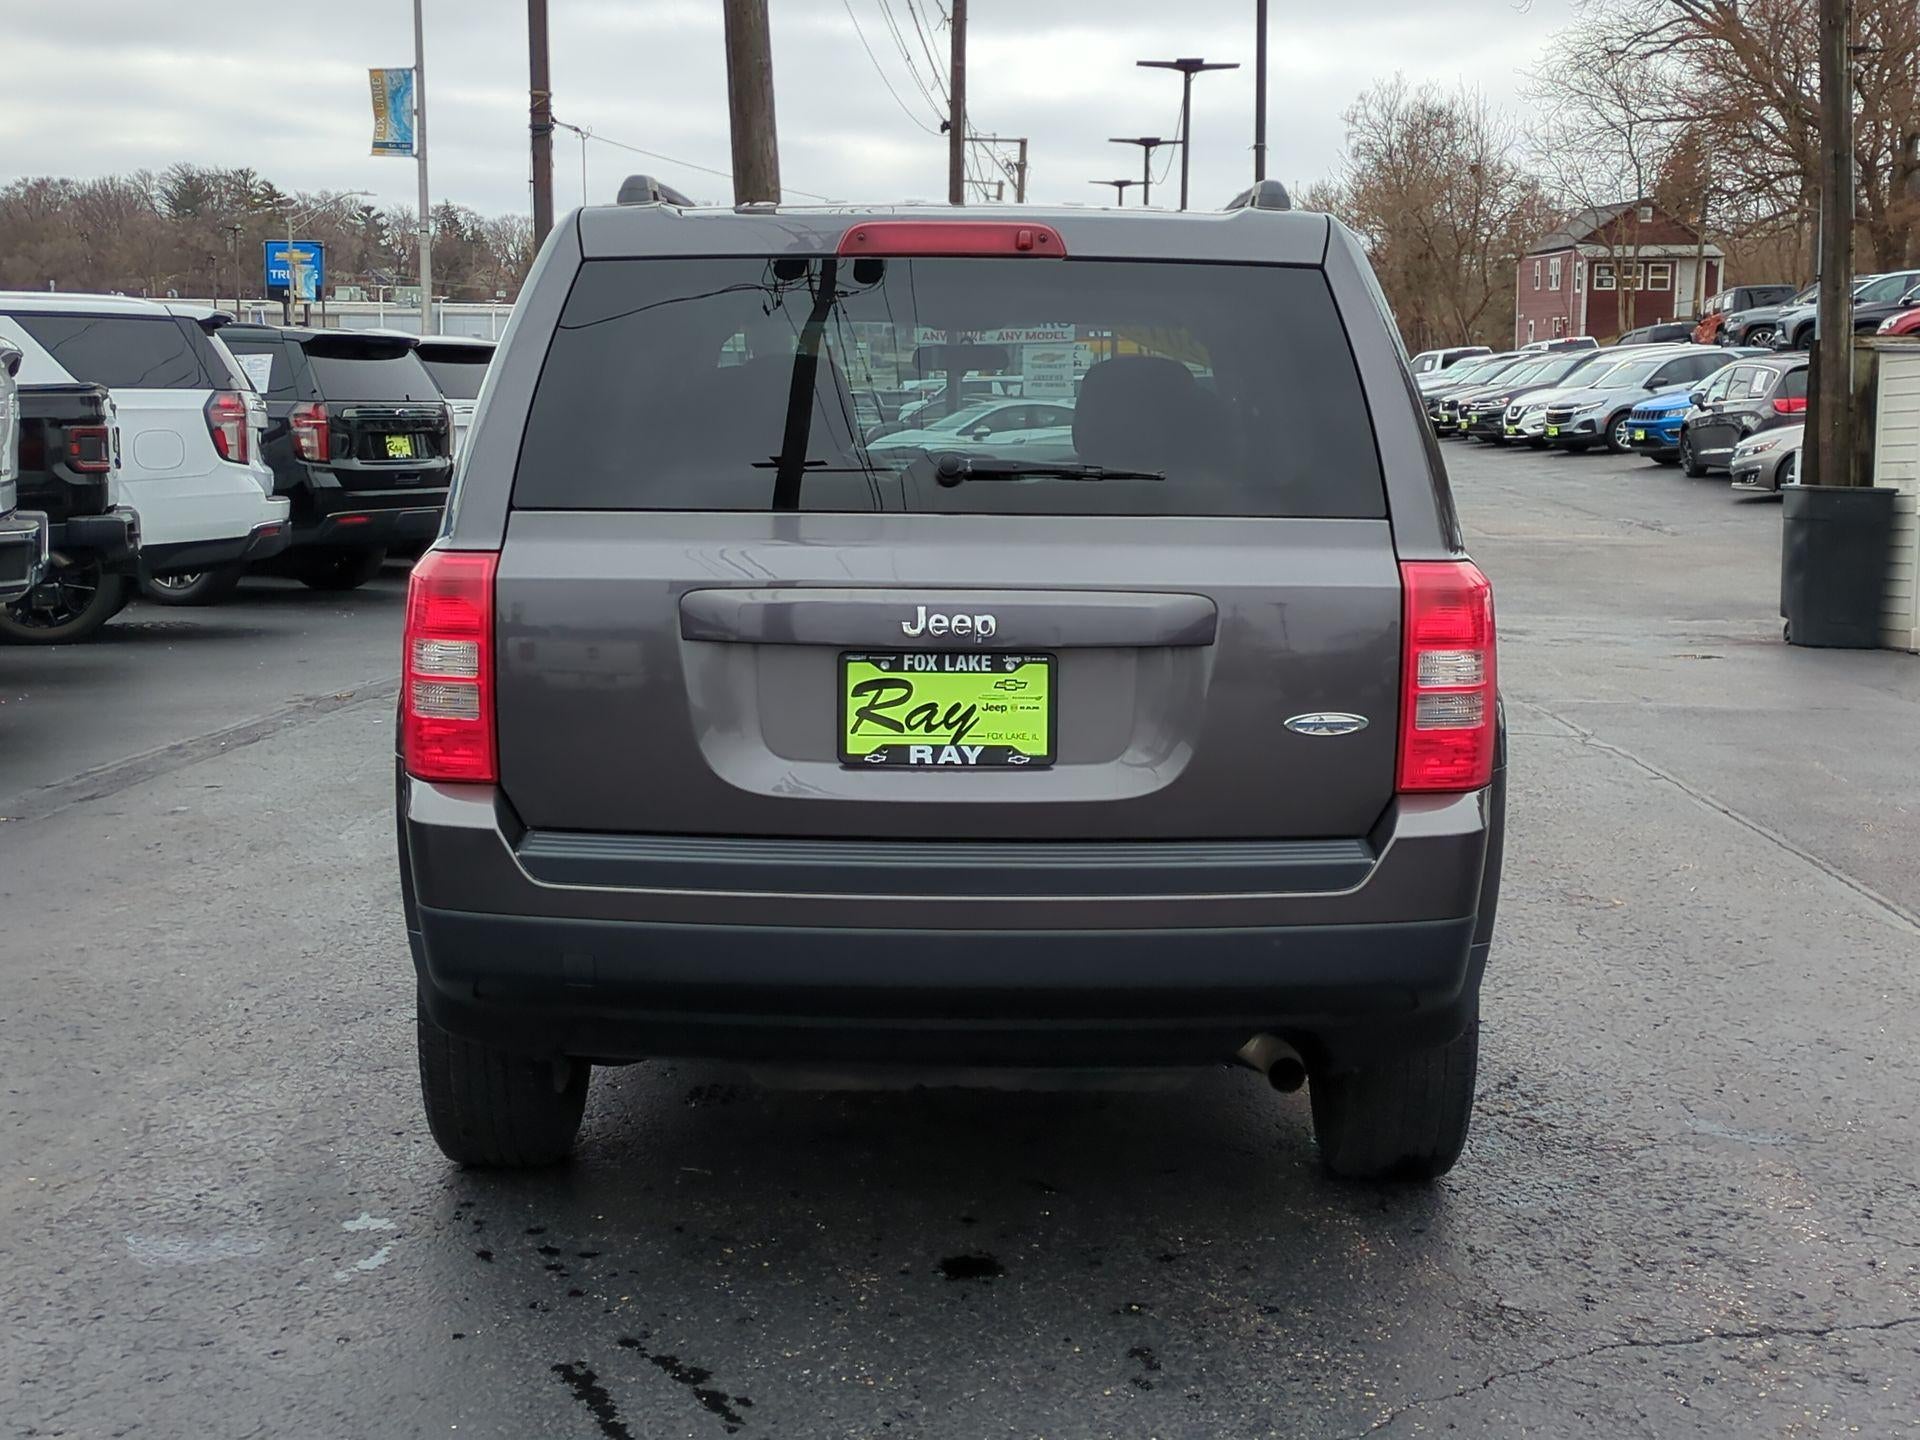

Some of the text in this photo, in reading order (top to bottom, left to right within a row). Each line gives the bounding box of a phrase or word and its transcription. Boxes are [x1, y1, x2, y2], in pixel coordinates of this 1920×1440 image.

[372, 78, 385, 140] FOX LAKE
[922, 330, 946, 341] ANY
[996, 330, 1022, 341] ANY
[1024, 330, 1067, 340] MODEL
[901, 606, 996, 644] Jeep
[903, 654, 992, 671] FOX LAKE
[1002, 655, 1022, 663] Jeep
[850, 677, 980, 745] Ray
[981, 702, 1008, 713] Jeep
[986, 732, 1040, 741] FOX LAKE, IL
[909, 745, 985, 765] RAY
